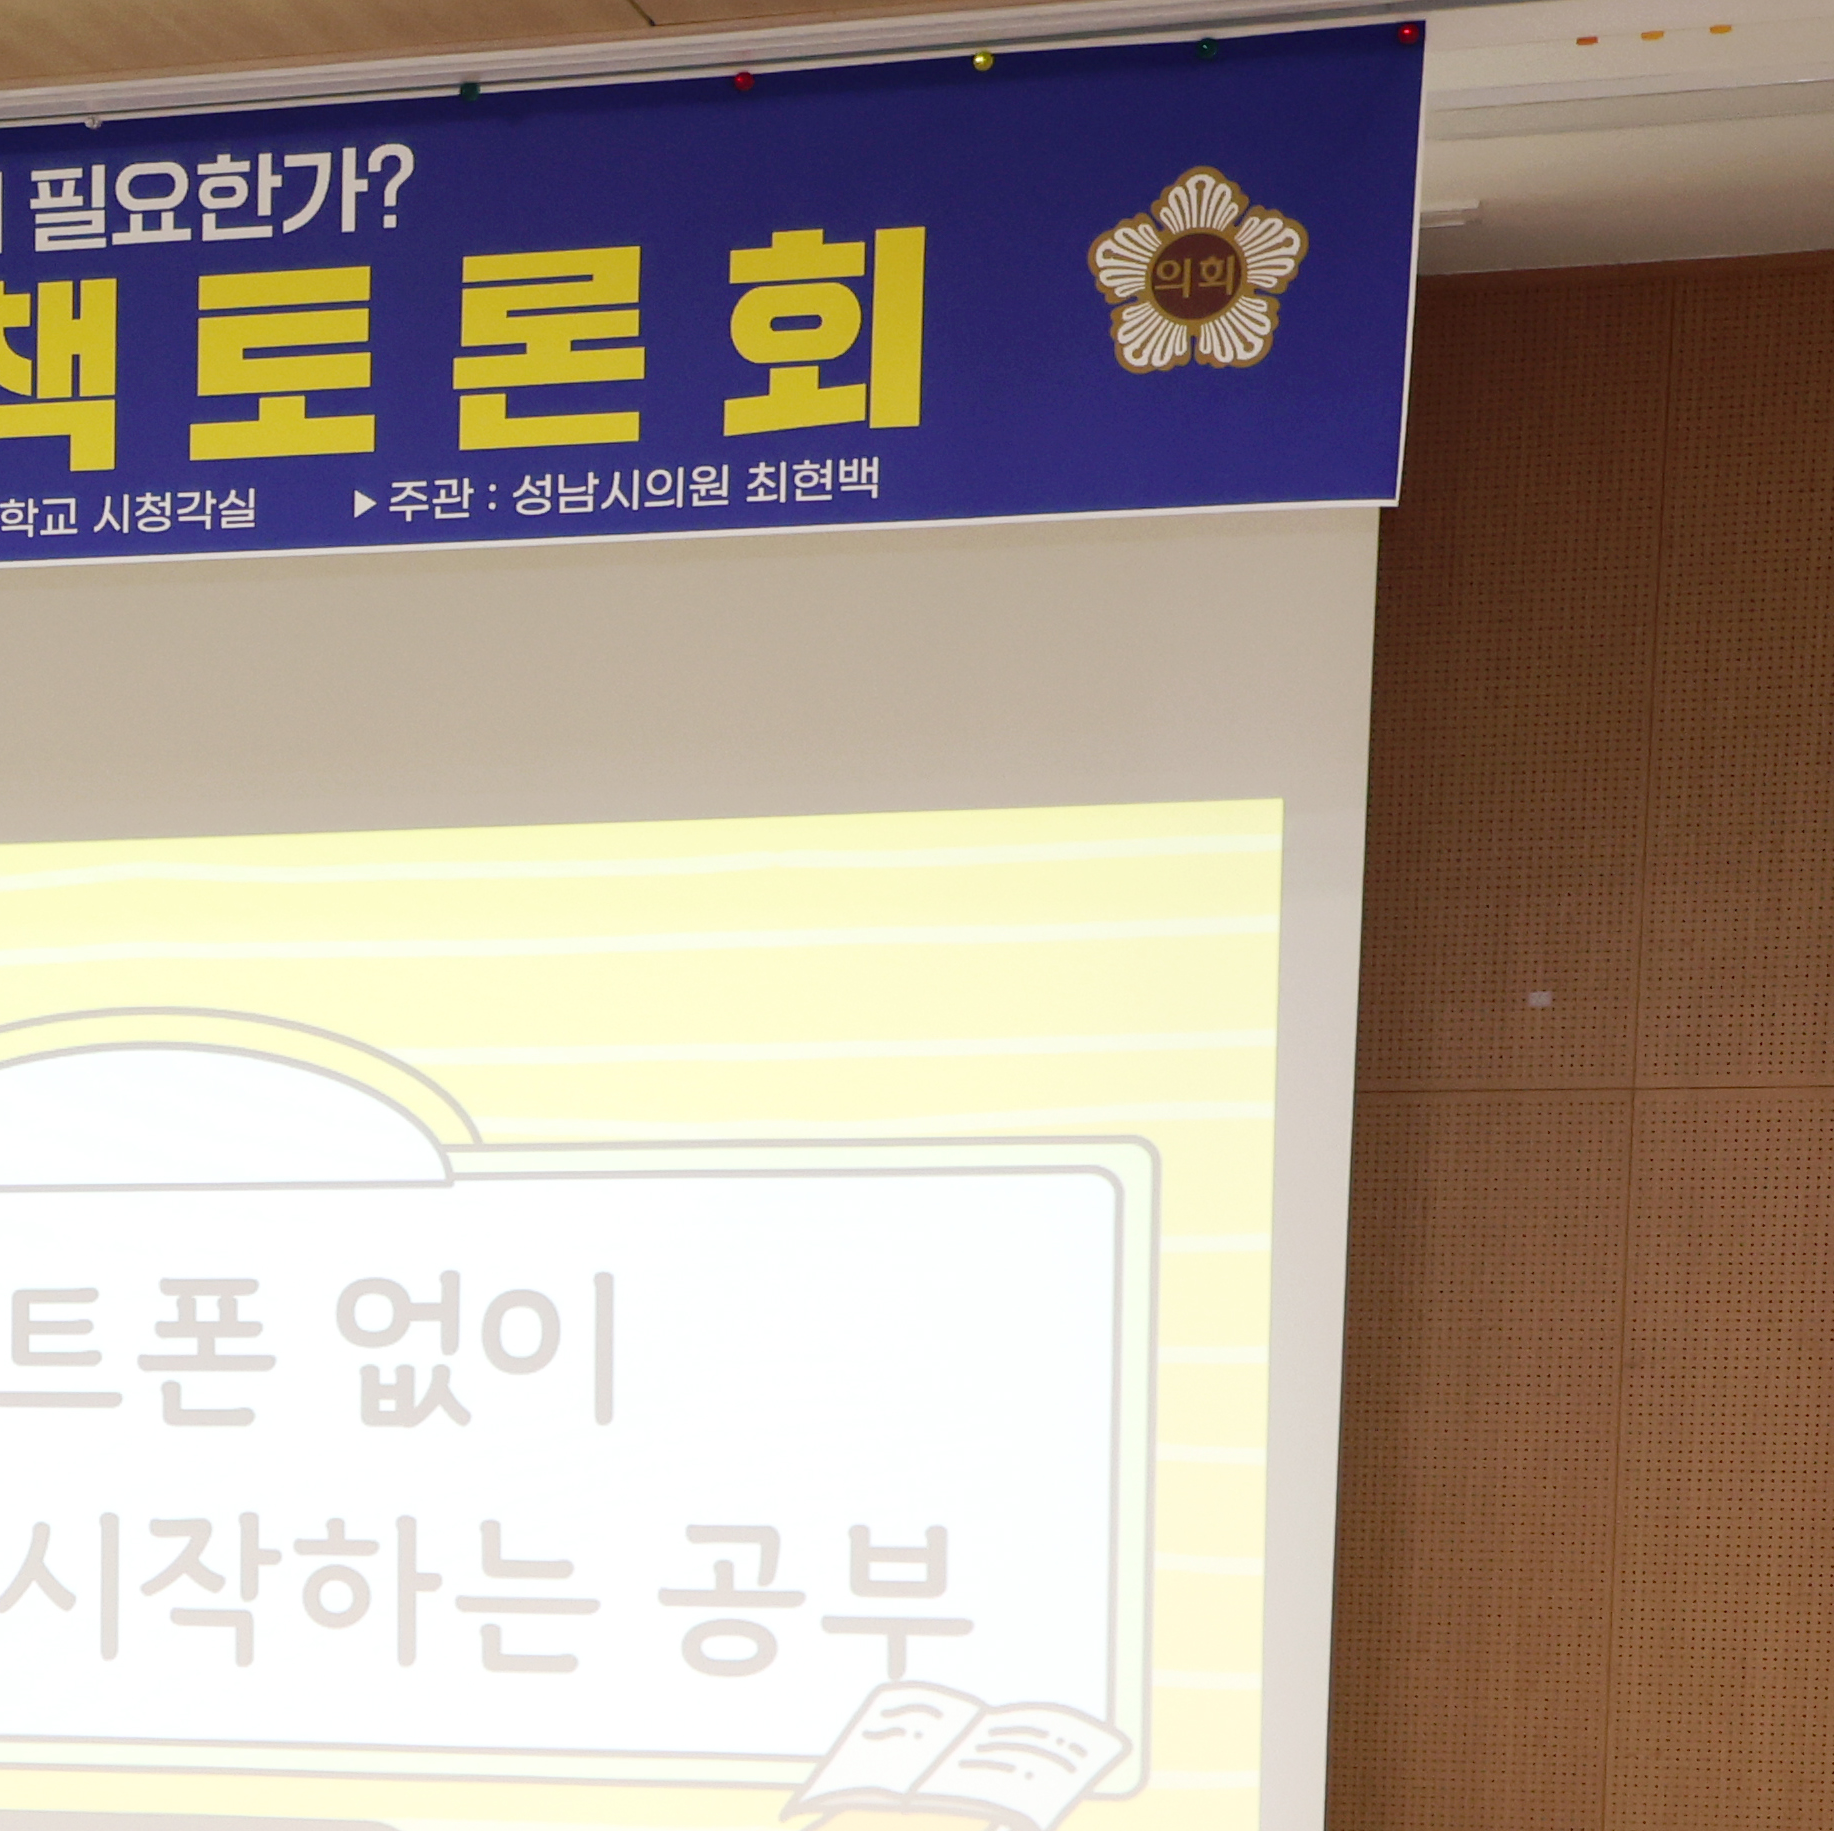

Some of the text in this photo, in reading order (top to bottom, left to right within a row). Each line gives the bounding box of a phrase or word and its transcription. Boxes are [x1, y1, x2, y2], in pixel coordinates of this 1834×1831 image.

[30, 144, 413, 251] 필요한가?
[1154, 255, 1236, 299] 의회
[93, 488, 256, 534] 시청각실
[388, 478, 475, 522] 주관
[512, 465, 729, 516] 성남시의원
[746, 456, 879, 504] 최현백
[336, 1269, 615, 1428] 없이
[658, 1523, 974, 1680] 공부
